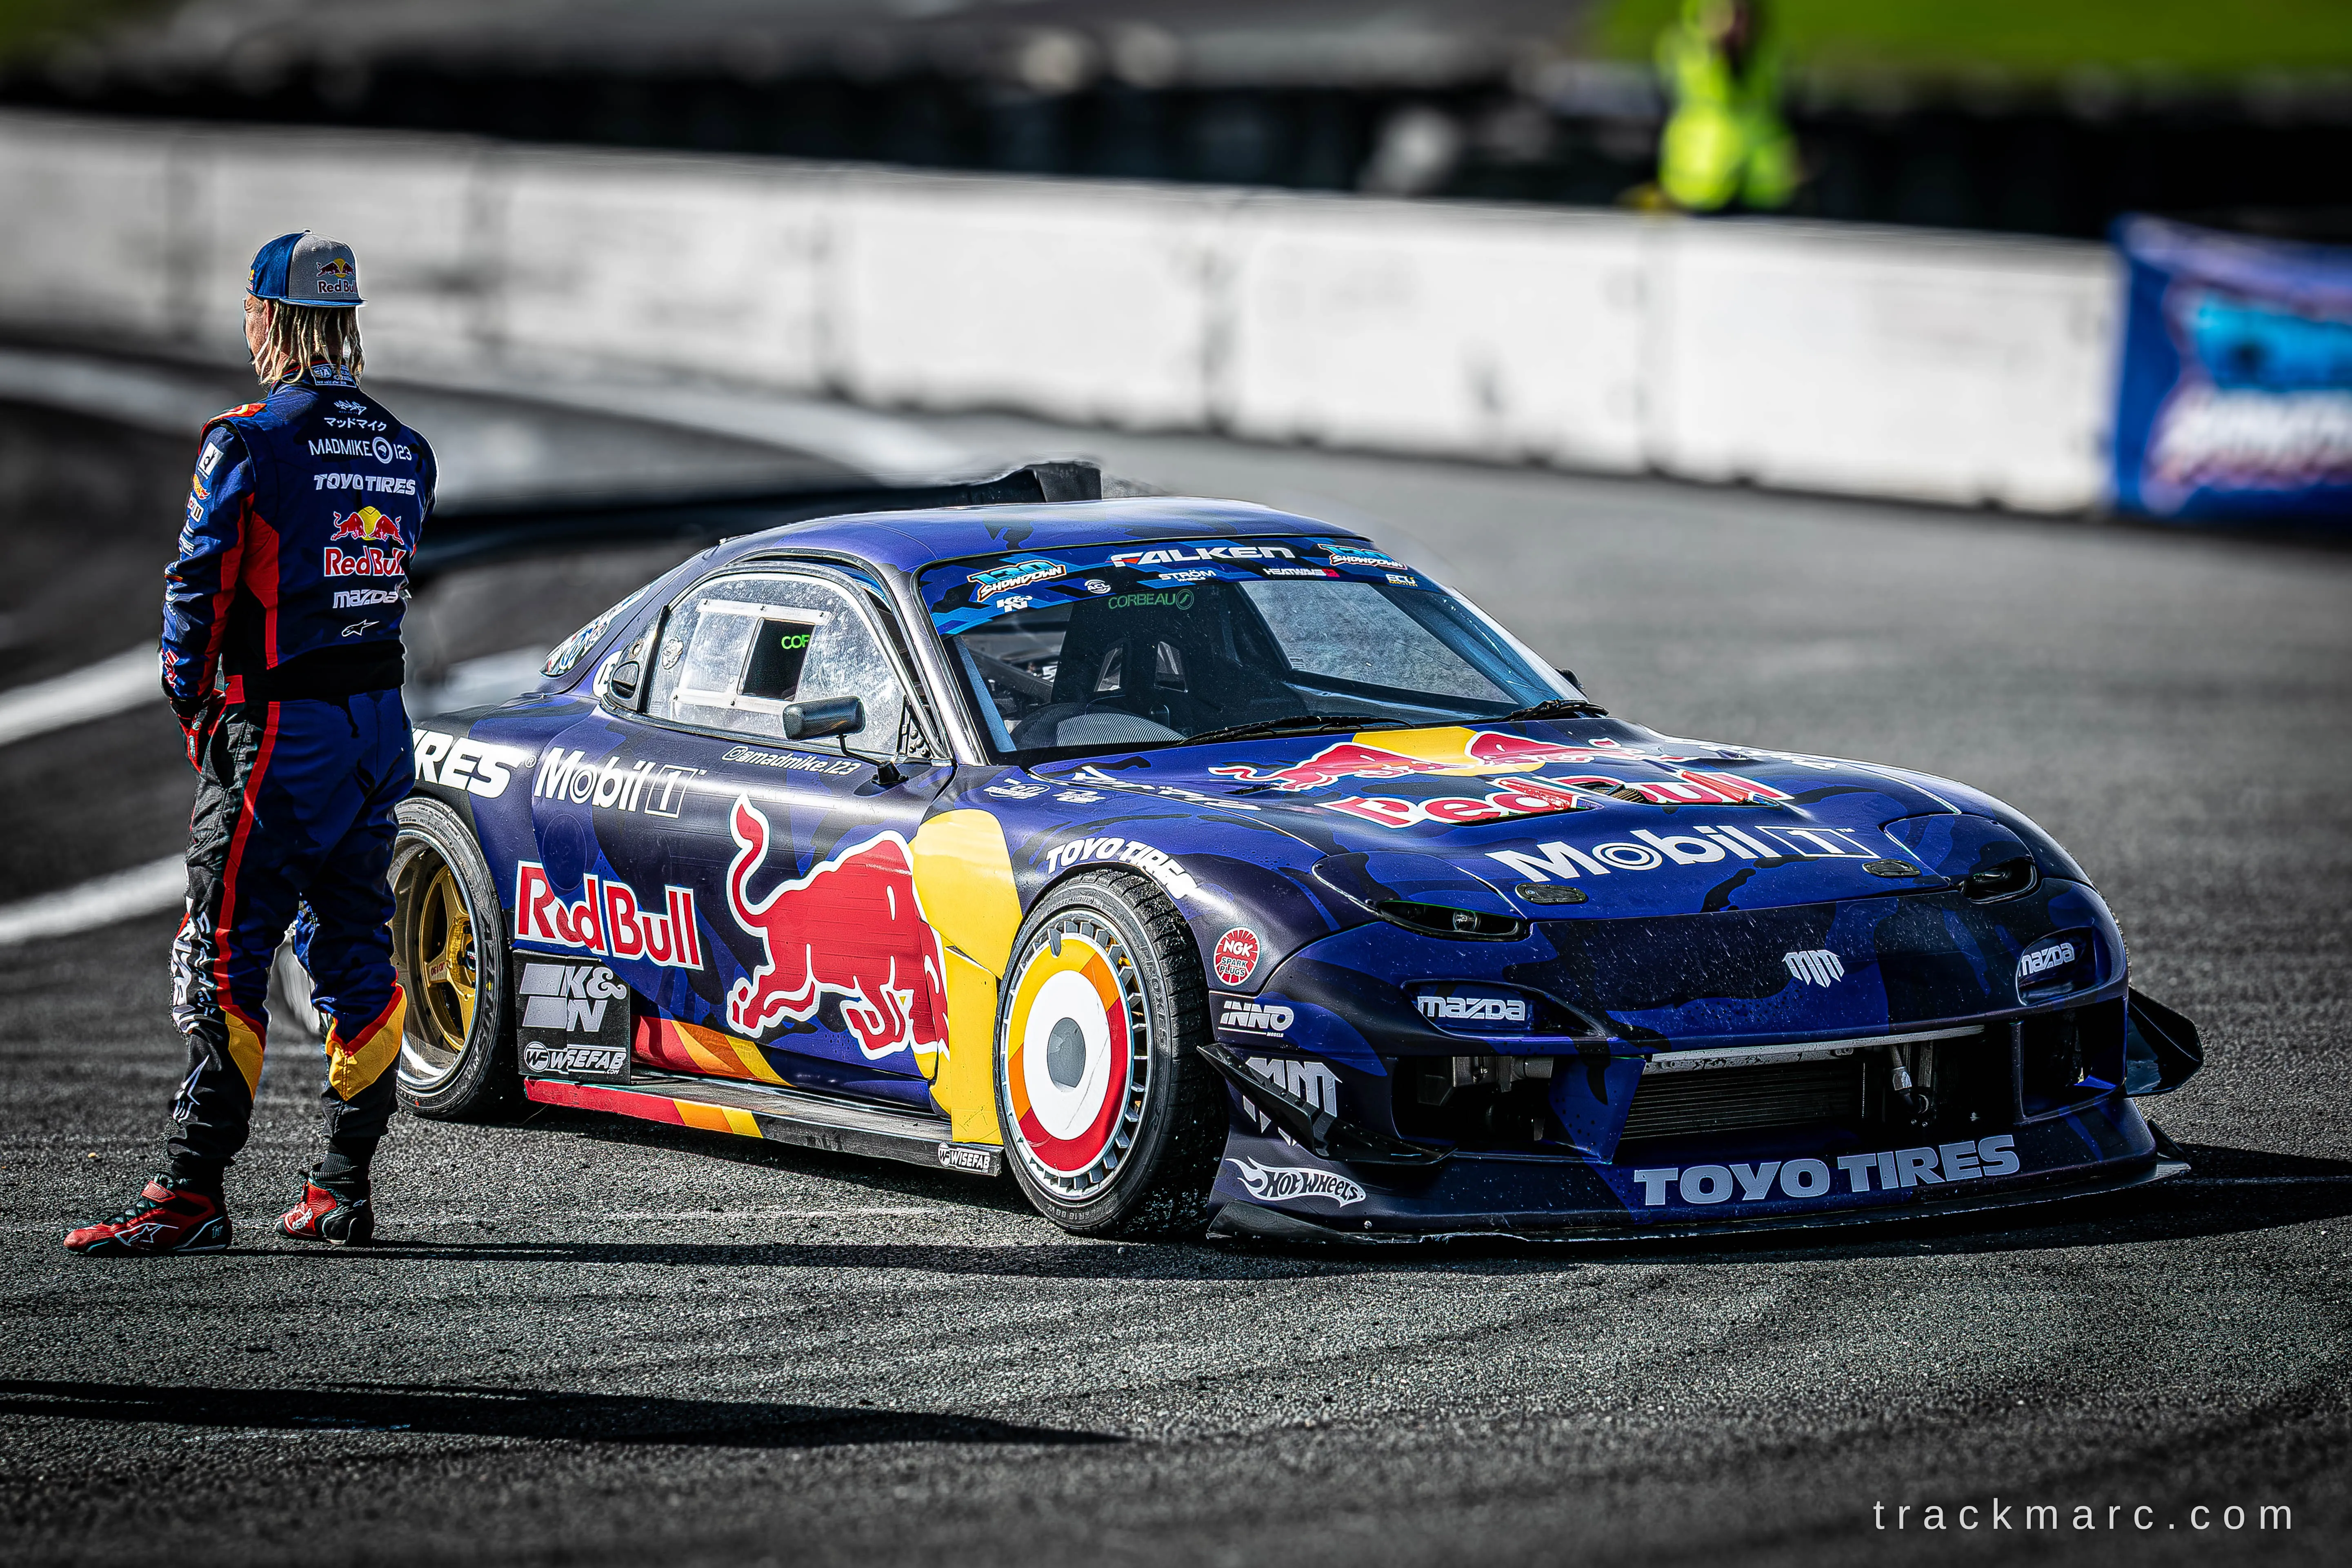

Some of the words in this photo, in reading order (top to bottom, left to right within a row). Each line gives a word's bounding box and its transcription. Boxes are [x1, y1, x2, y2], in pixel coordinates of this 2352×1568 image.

[317, 279, 342, 294] Red
[324, 418, 387, 431] マッドマイク
[308, 438, 373, 456] MADMIKE
[393, 444, 412, 461] 123
[314, 473, 363, 490] TOYO
[365, 476, 416, 495] TIRES
[324, 545, 371, 577] Red
[1111, 546, 1296, 567] FALKEN
[1332, 555, 1403, 567] SHOWDOWN
[971, 562, 1054, 584] 130
[980, 567, 1062, 598] SHOWDOWN
[1158, 570, 1216, 580] STRÖM
[1385, 574, 1416, 584] ECU
[1087, 583, 1110, 591] ACL
[332, 589, 399, 609] mazda
[1108, 593, 1176, 609] CORBEAU
[534, 747, 656, 812] Mobil
[1046, 837, 1125, 875] TOYO
[1484, 824, 1782, 882] Mobil
[514, 860, 609, 956] Red
[602, 879, 704, 971] Bull
[1223, 940, 1254, 958] NGK
[2018, 942, 2075, 977] mazda
[1219, 965, 1246, 976] PLUGS
[1220, 957, 1248, 967] SPARK
[1417, 996, 1525, 1021] mazda
[951, 1150, 990, 1169] WISEFAB
[1634, 1158, 1830, 1206] TOYO
[1837, 1134, 2020, 1192] TIRES
